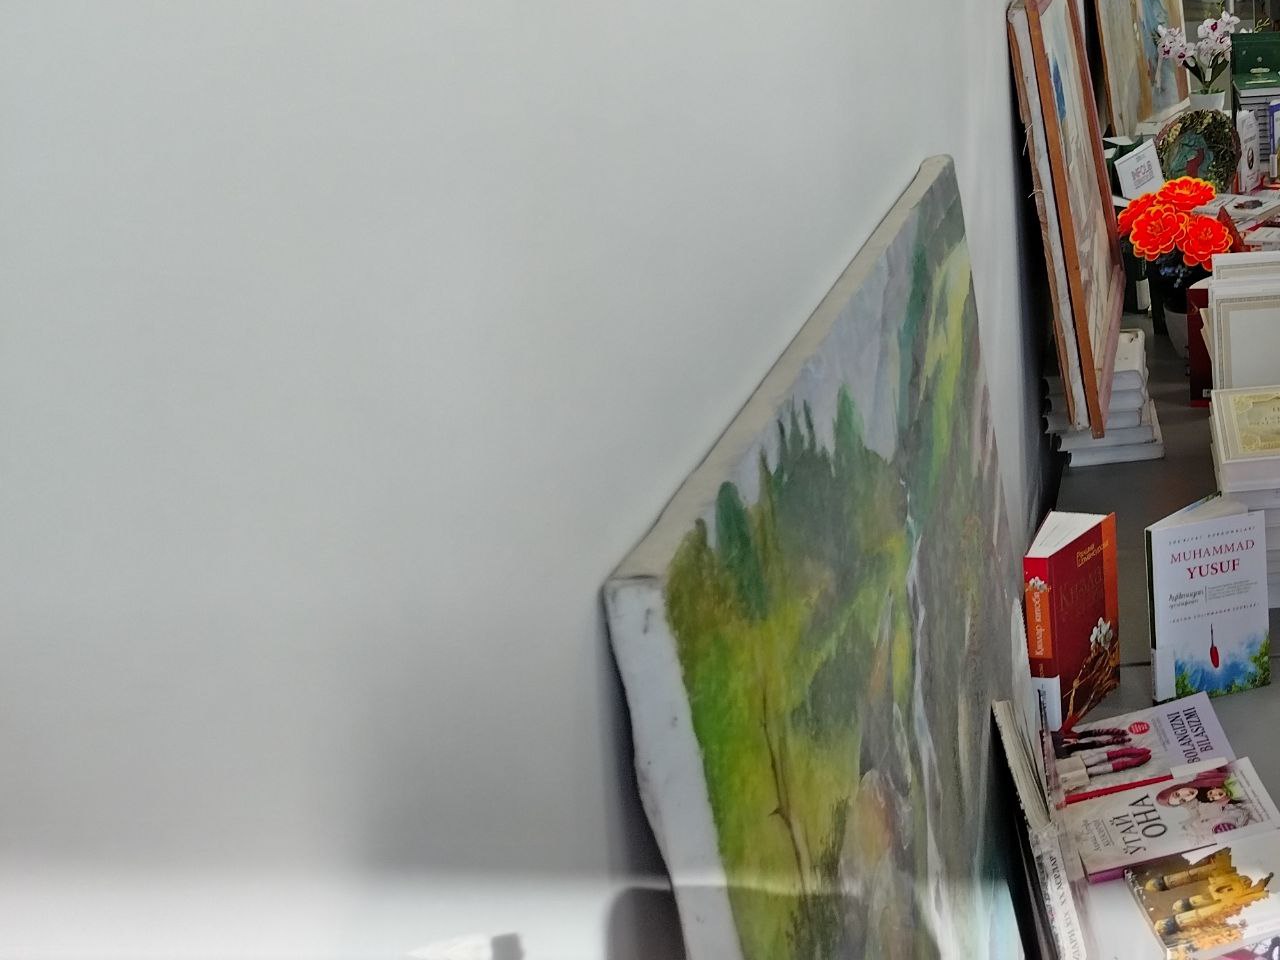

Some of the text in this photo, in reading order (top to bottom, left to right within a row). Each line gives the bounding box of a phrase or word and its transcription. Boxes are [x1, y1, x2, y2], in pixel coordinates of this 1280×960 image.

[1169, 539, 1256, 565] MUHAMMAD
[1186, 558, 1241, 580] YUSUF
[1166, 711, 1200, 765] BOLANGIZNI
[1182, 706, 1214, 754] BILASIZMI
[1109, 813, 1147, 856] ЎГАЙ
[1128, 793, 1169, 839] ОНА
